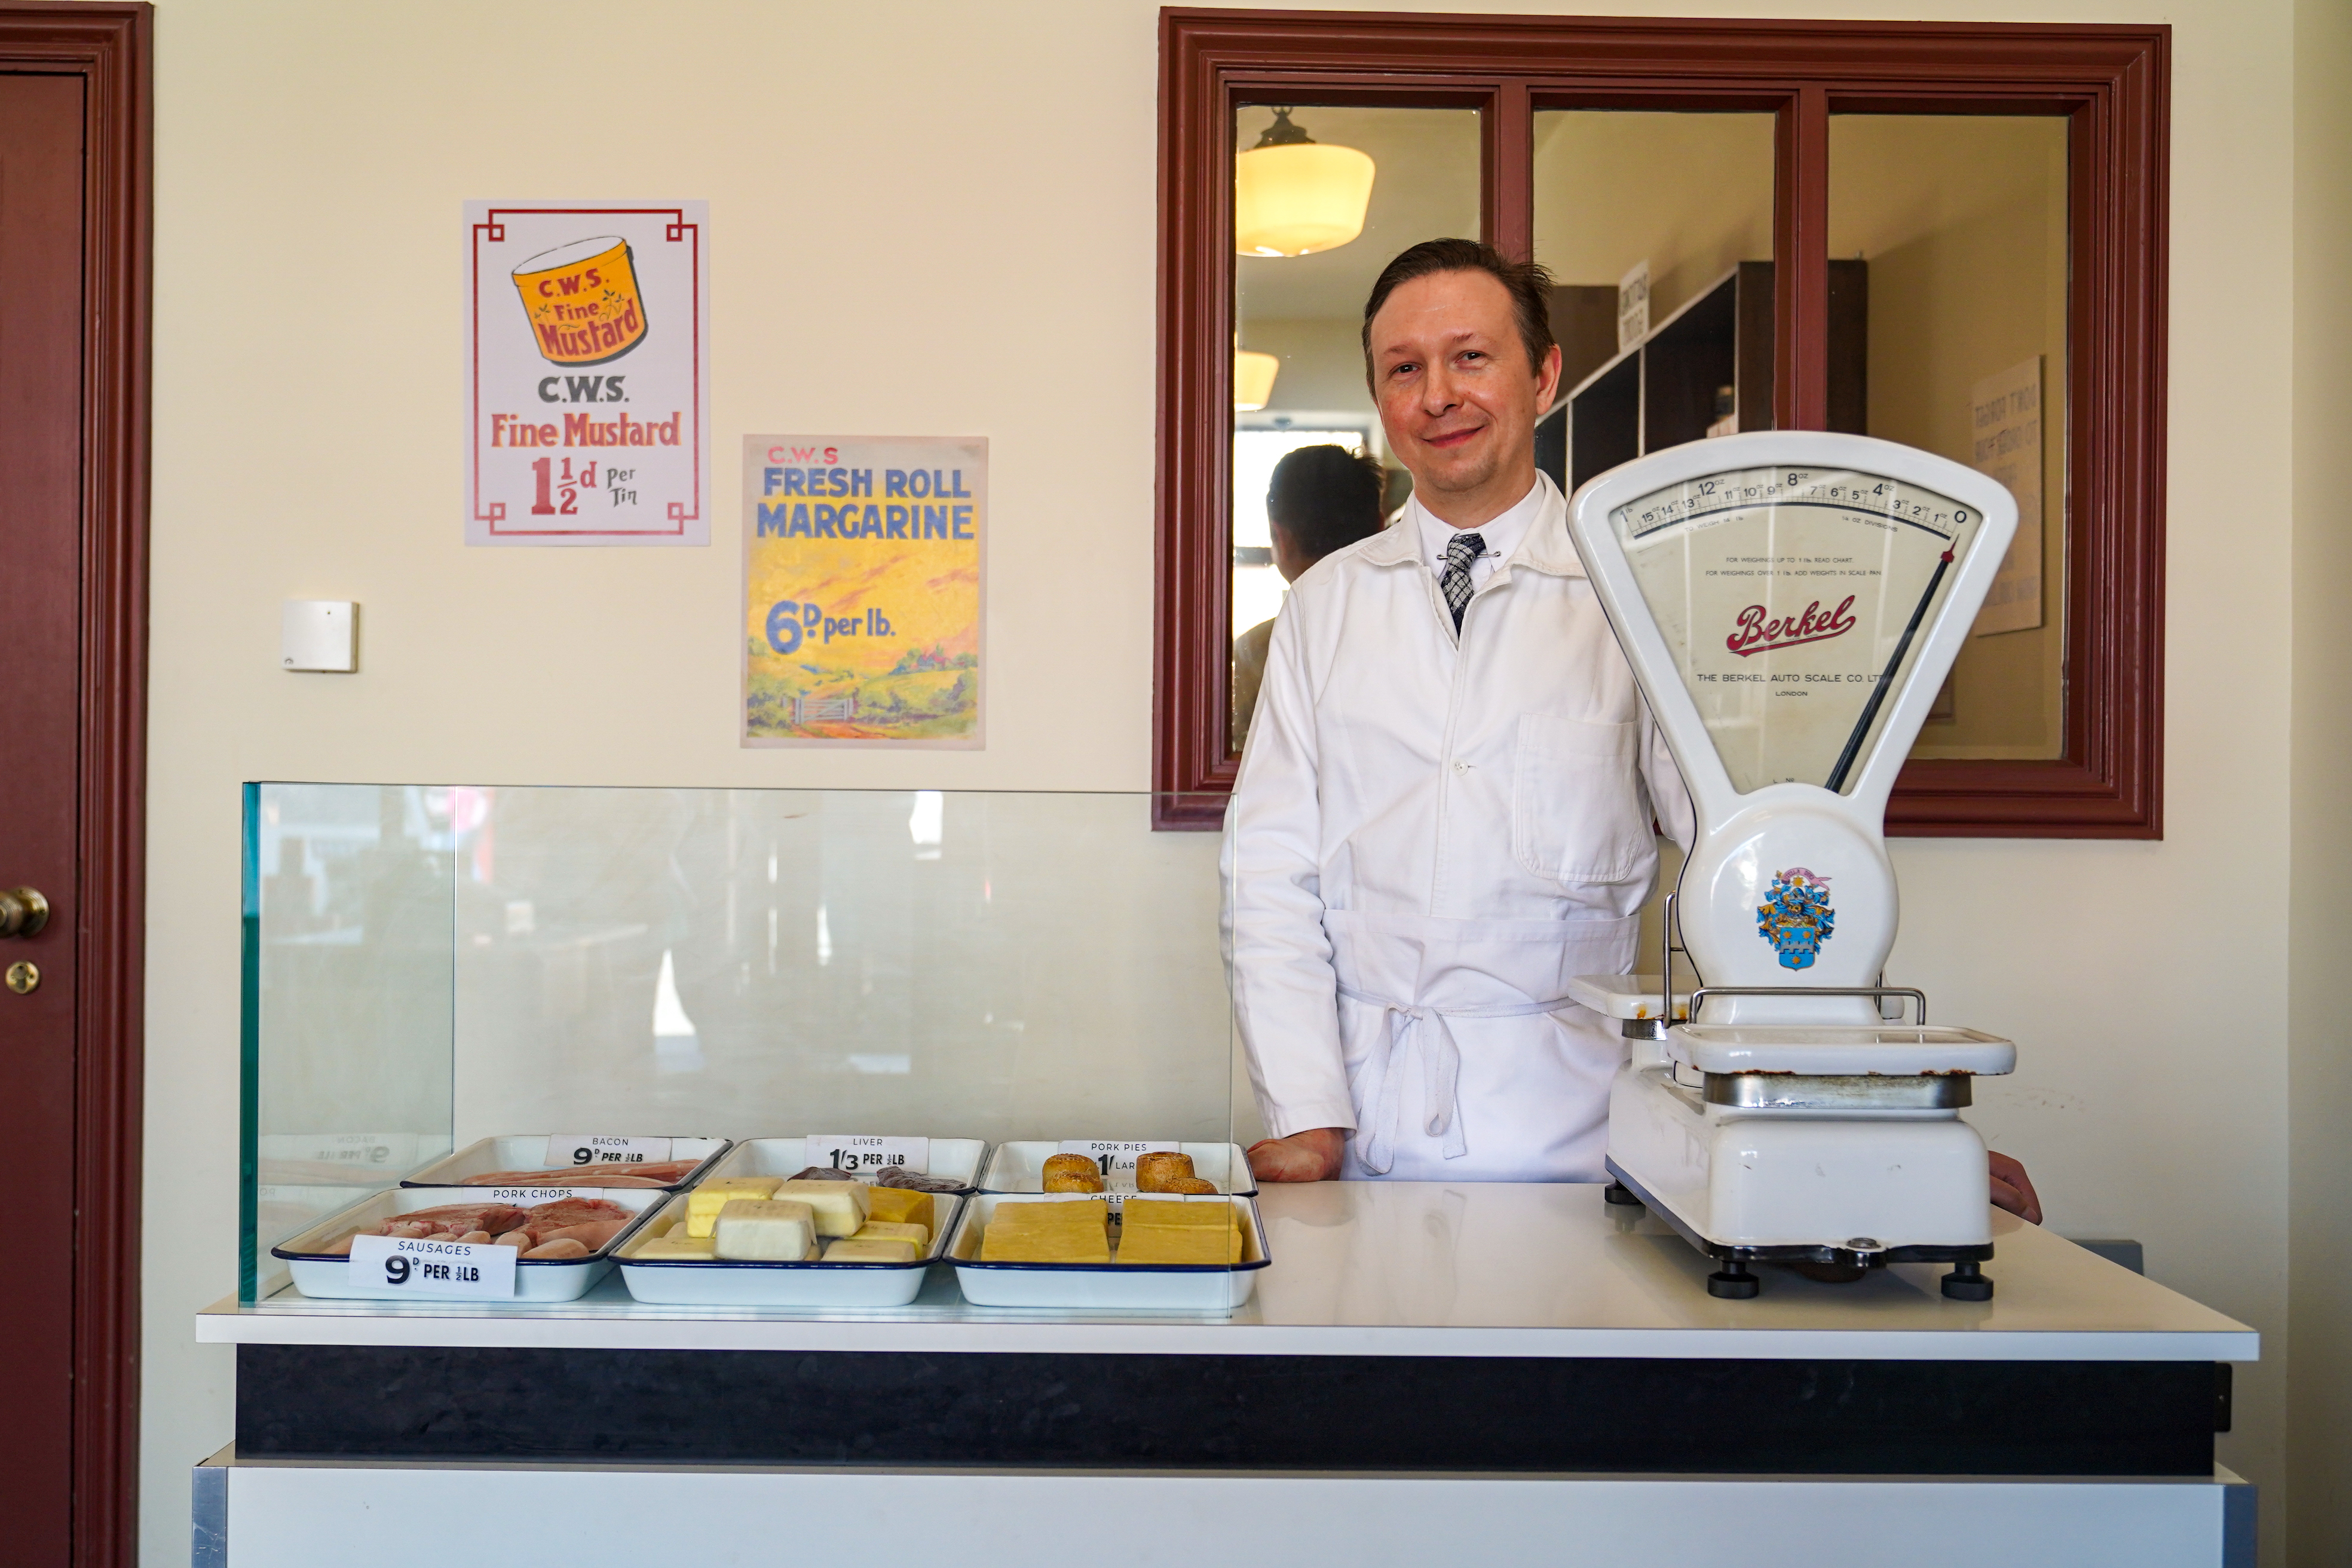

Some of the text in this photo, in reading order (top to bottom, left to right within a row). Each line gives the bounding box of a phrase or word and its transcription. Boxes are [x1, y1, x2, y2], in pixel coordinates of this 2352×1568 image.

[539, 268, 610, 298] C.W.S.
[554, 302, 600, 321] Fine
[539, 298, 638, 357] Mustard
[538, 376, 630, 403] C.W.S.
[491, 412, 682, 448] Fine Mustard
[767, 446, 838, 465] C.W.S
[764, 467, 972, 498] FRESH ROLL
[609, 488, 637, 507] Tin
[757, 503, 975, 540] MARGARINE
[1696, 520, 1720, 529] WEIGH
[1864, 519, 1898, 532] DIVISIONS
[823, 616, 863, 644] per
[867, 608, 896, 636] lb.
[1726, 595, 1856, 653] Berkel
[602, 1153, 621, 1162] PER
[863, 1154, 883, 1165] PER
[494, 1189, 572, 1198] PORK CHOPS
[1107, 1212, 1123, 1225] PE
[398, 1241, 471, 1255] SAUSAGES
[424, 1264, 449, 1279] PER
